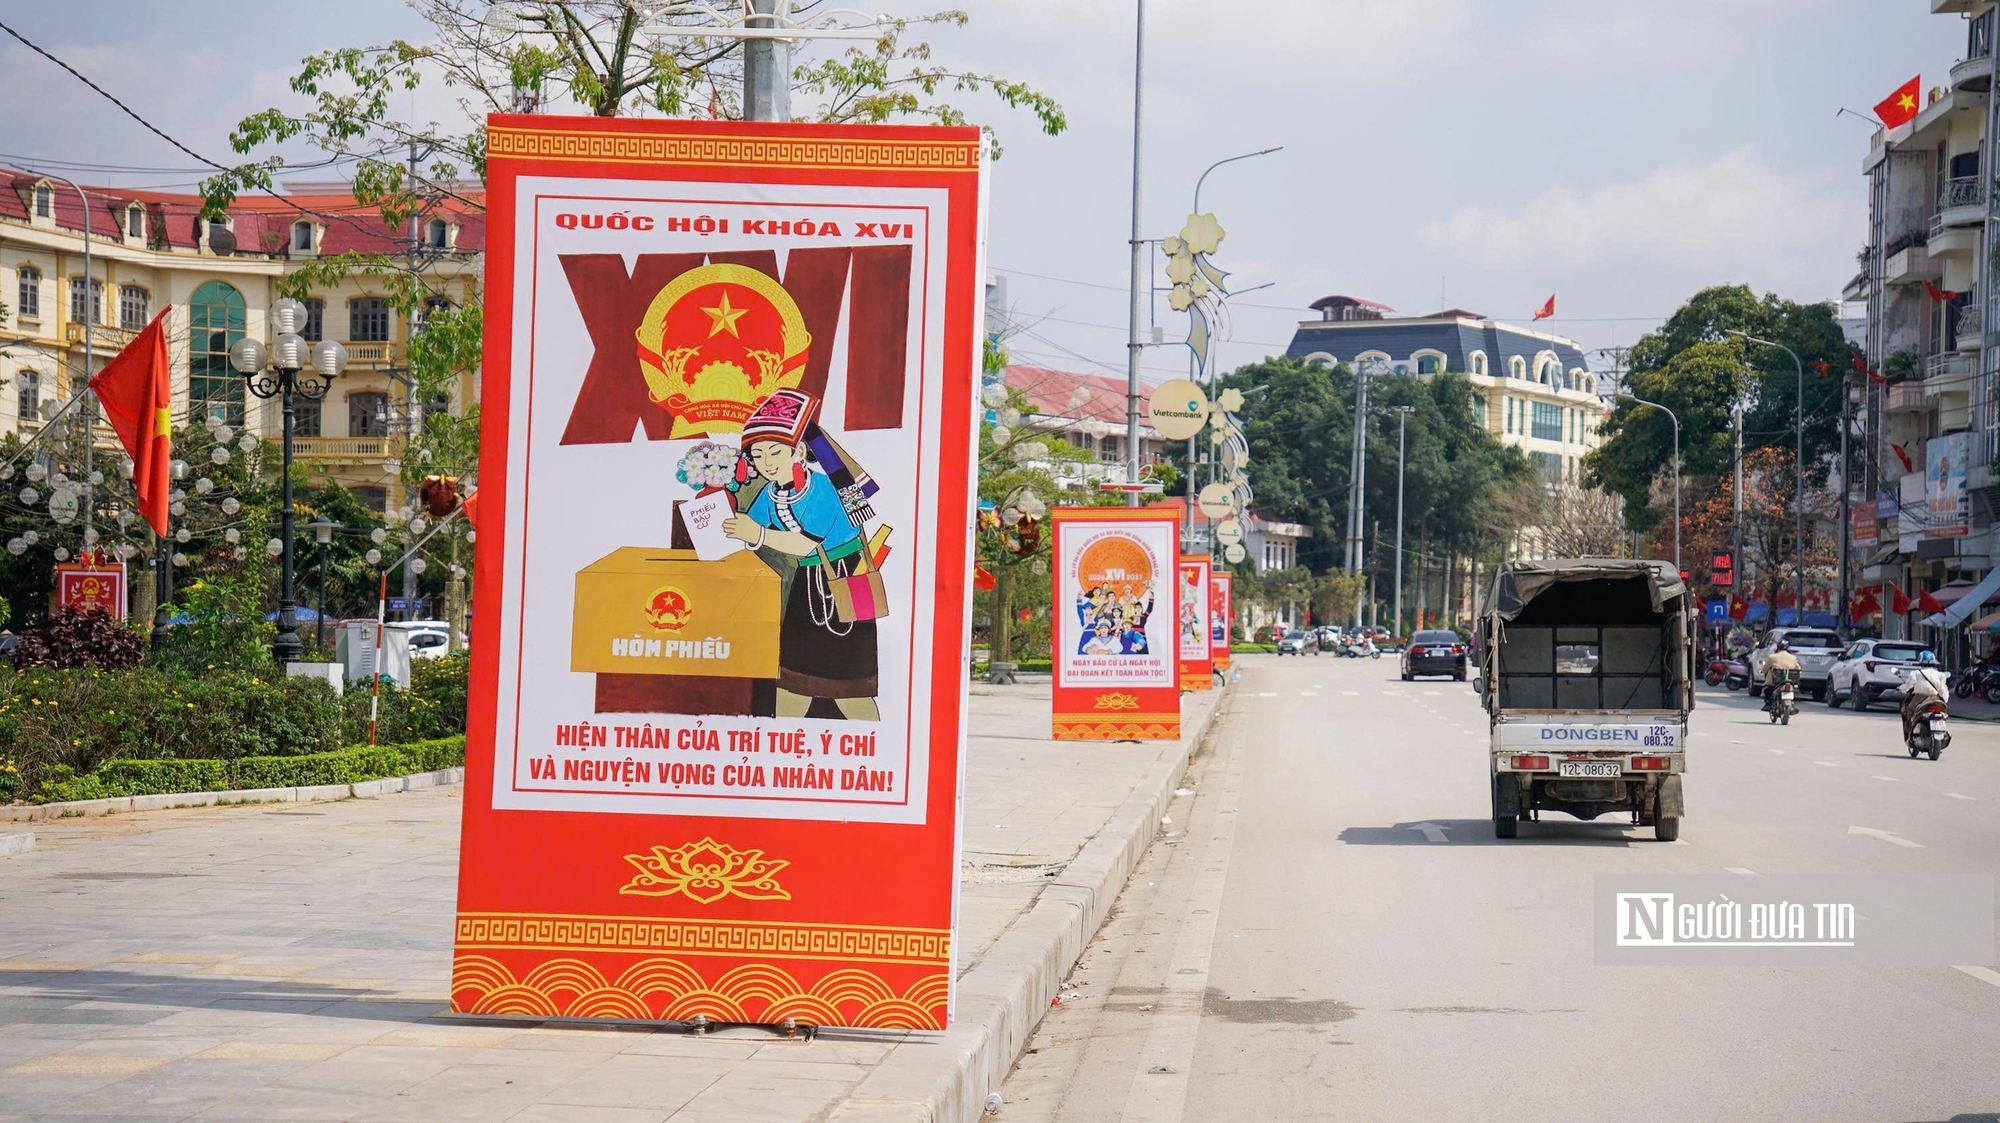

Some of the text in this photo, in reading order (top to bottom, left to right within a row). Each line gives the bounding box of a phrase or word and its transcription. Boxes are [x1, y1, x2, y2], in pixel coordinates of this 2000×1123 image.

[555, 210, 913, 239] QUỐC HỘI KHÓA XVI
[696, 408, 746, 420] VIỆT NAM
[1153, 409, 1203, 419] Vietcombank
[1105, 568, 1125, 581] XVI
[611, 633, 731, 660] HÒM PHIẾU
[1541, 728, 1638, 741] DONGBEN
[1649, 726, 1670, 736] 12C-
[556, 720, 876, 759] HIỆN THÂN CỦA TRÍ TUỆ, Ý CHÍ
[1643, 736, 1674, 747] 080.32
[529, 754, 894, 792] VÀ NGUYỆN VỌNG CỦA NHÂN DÂN!
[1562, 764, 1619, 776] 12C-080.32
